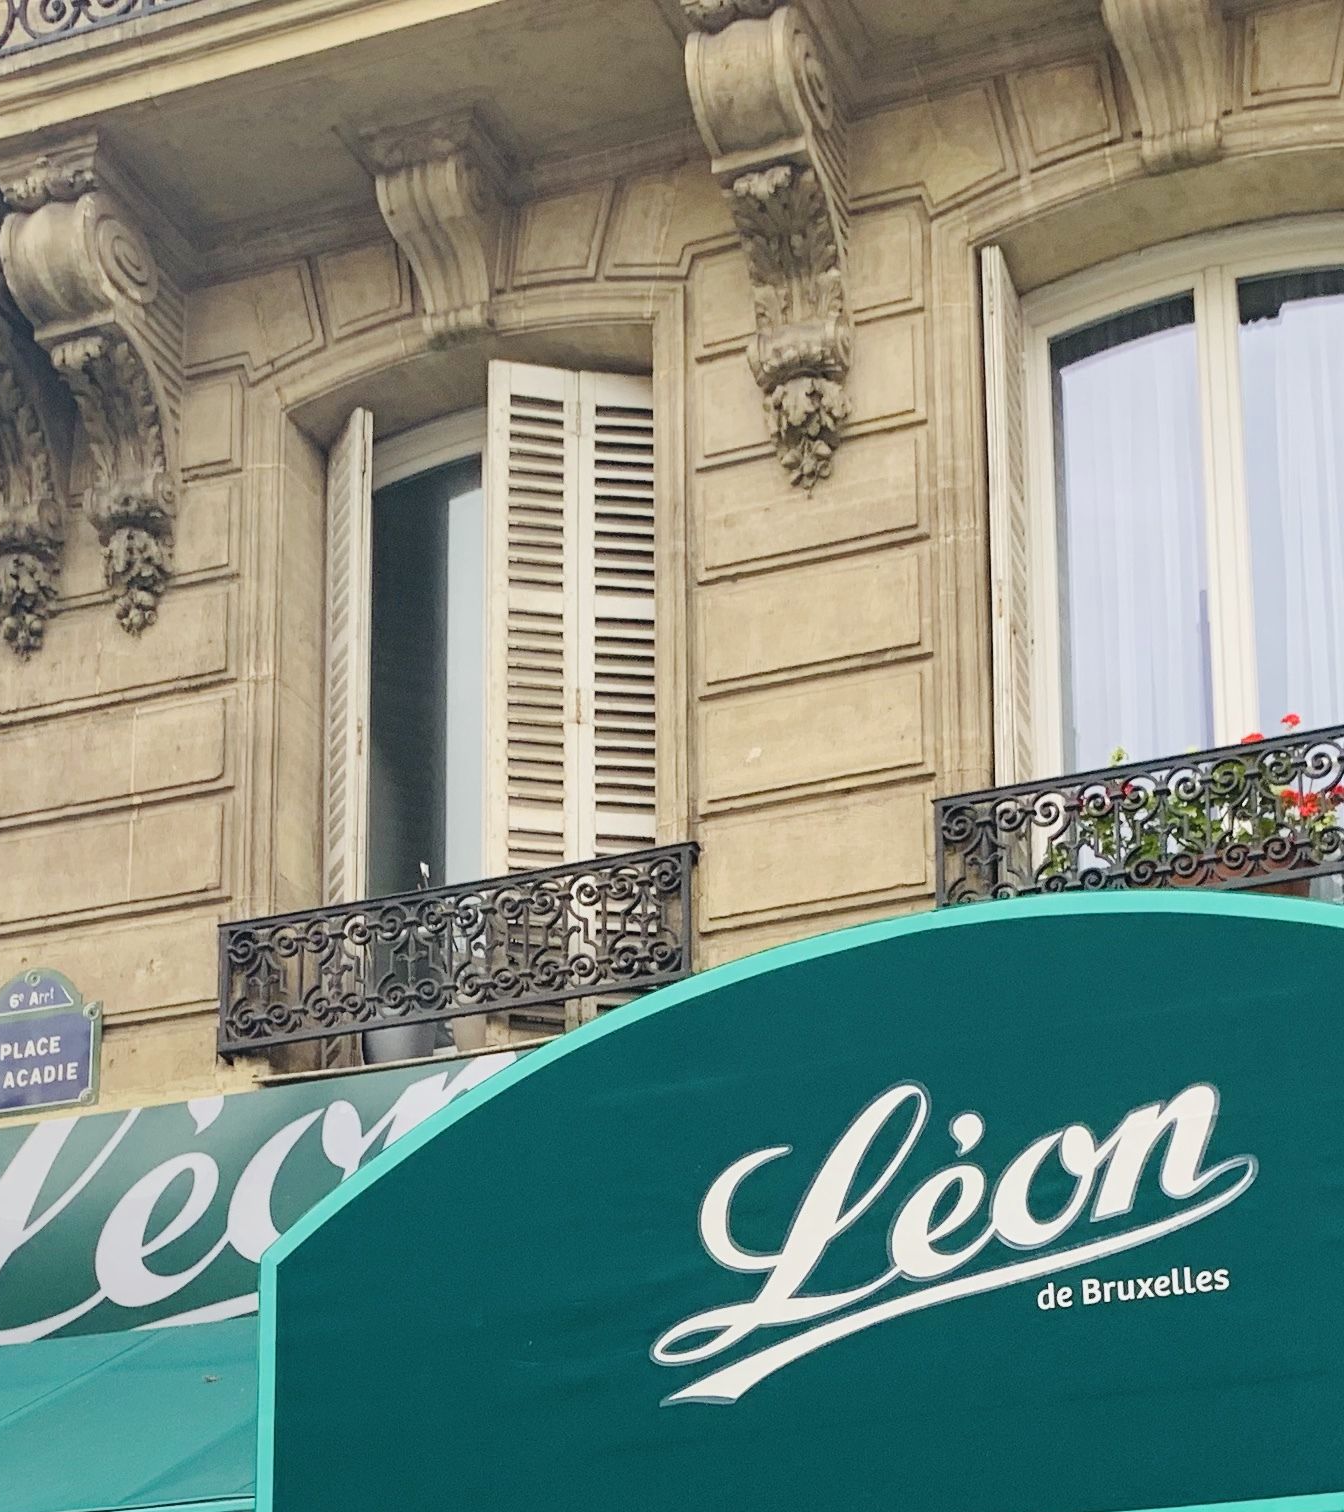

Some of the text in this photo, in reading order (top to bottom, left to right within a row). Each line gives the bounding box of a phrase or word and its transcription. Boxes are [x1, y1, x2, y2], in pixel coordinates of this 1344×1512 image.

[0, 1035, 62, 1061] PLACE
[649, 1079, 1258, 1406] Léon
[1036, 1265, 1231, 1311] de Bruxelles
